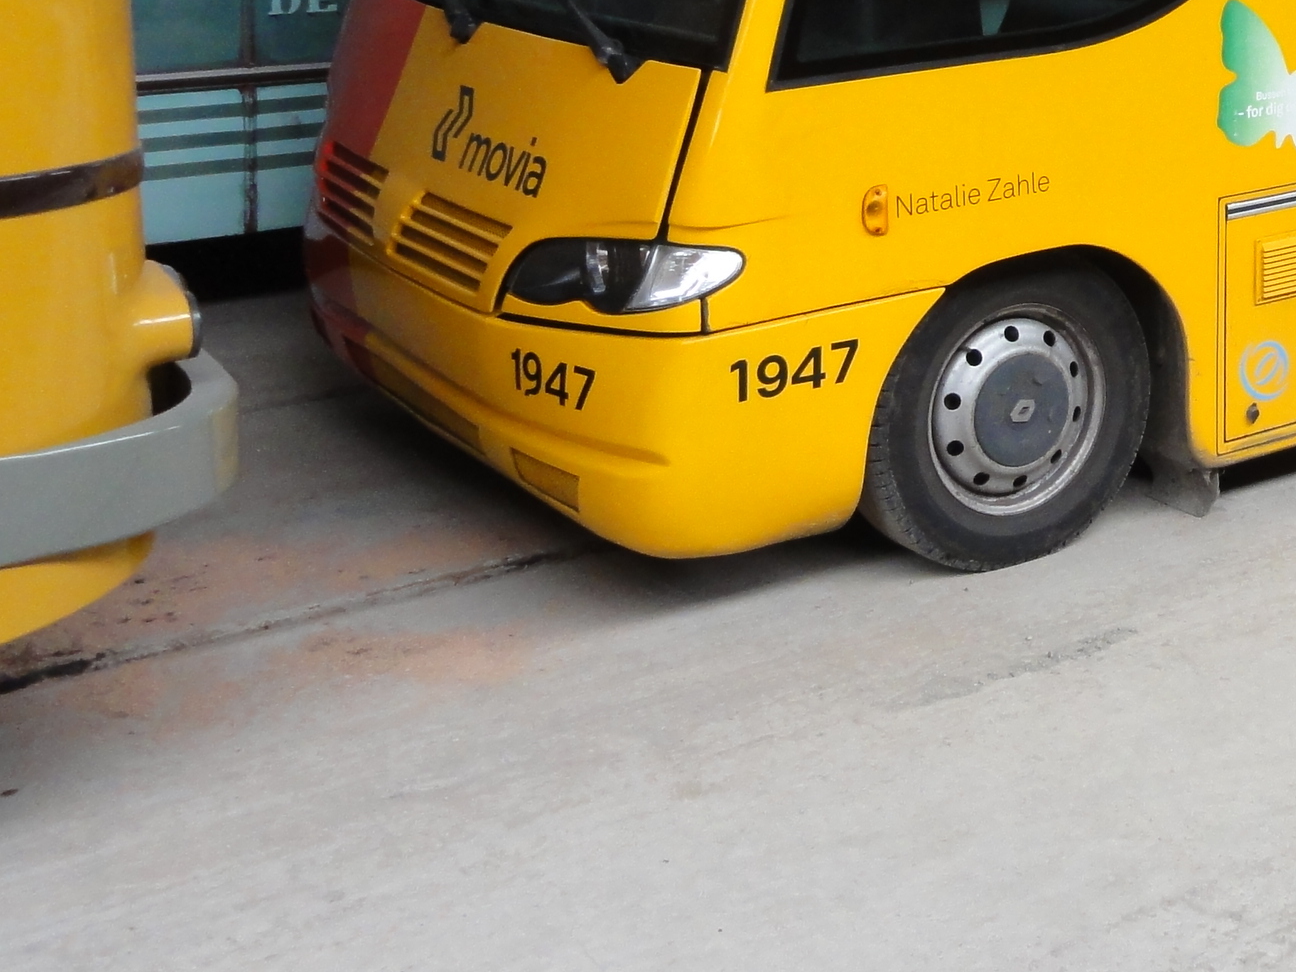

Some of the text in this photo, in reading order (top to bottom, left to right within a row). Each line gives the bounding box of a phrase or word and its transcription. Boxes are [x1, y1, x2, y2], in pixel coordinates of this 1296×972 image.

[1246, 104, 1263, 119] for
[1265, 102, 1284, 118] dig
[458, 131, 547, 198] movia
[895, 171, 1050, 219] Natalie Zahle
[510, 347, 597, 412] 1947
[729, 338, 860, 404] 1947
